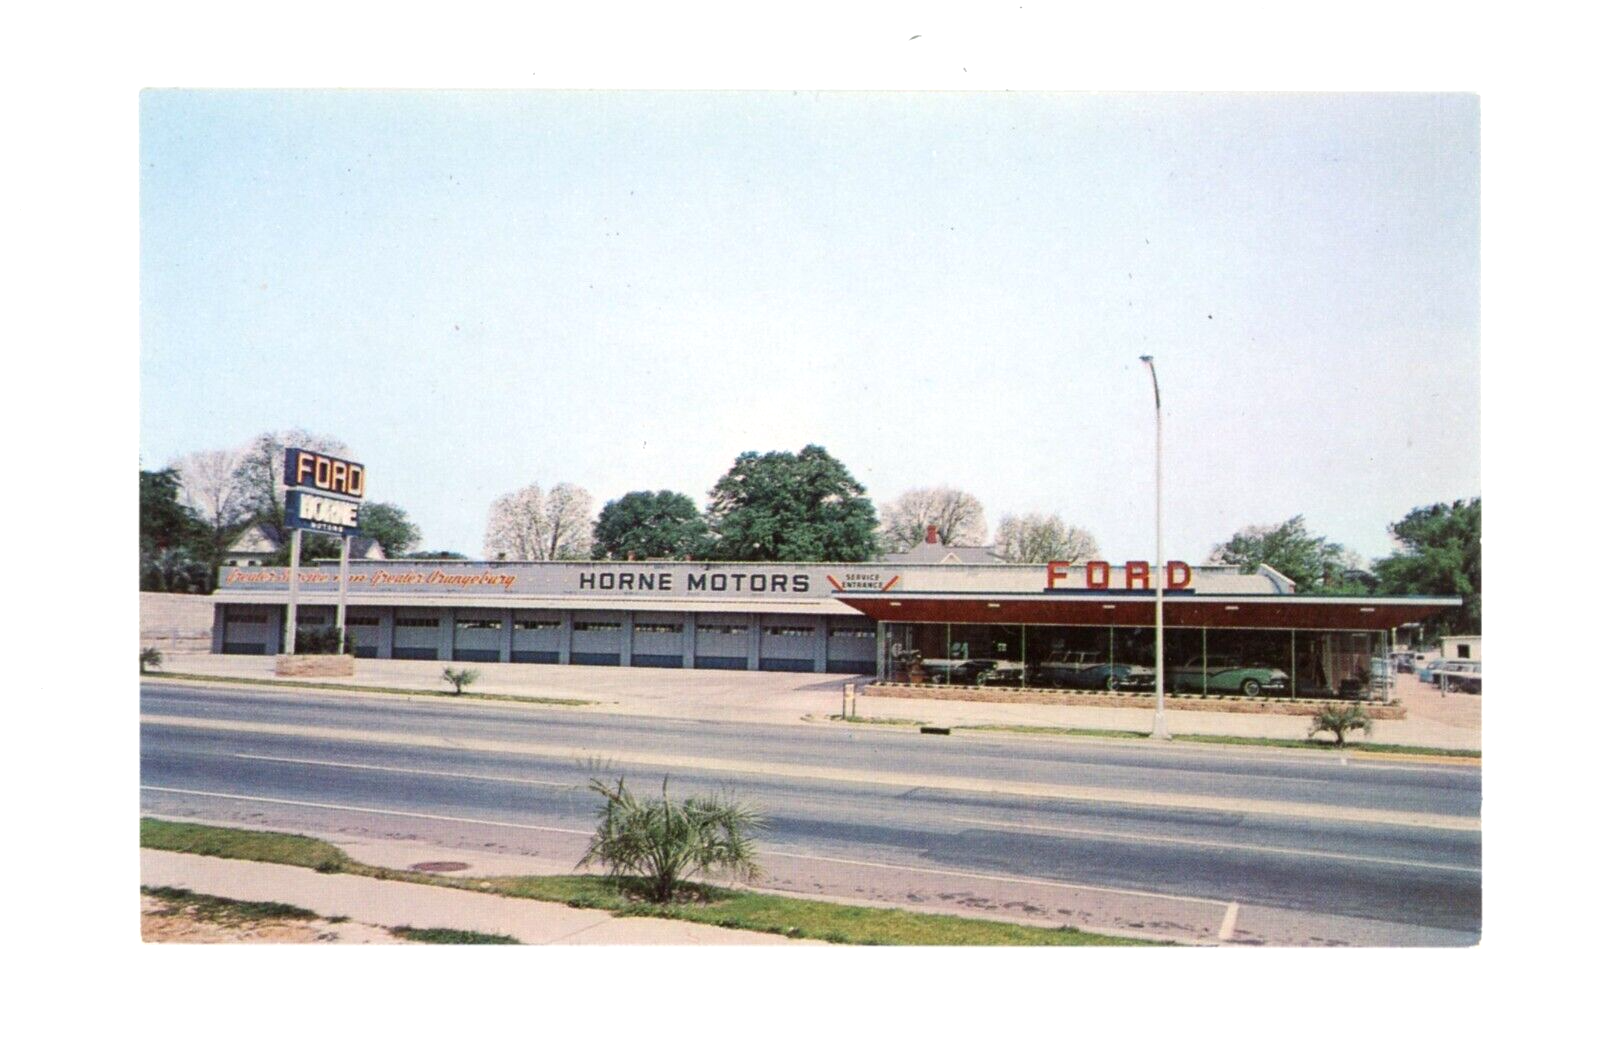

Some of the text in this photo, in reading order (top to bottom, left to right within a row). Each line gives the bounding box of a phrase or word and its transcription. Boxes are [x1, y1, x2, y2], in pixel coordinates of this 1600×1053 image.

[297, 451, 366, 497] FORD
[300, 493, 358, 527] HORNE
[371, 568, 424, 588] Greater
[425, 567, 516, 589] Orangeburg
[580, 572, 810, 593] HORNE MOTORS
[841, 581, 883, 589] ENTRANCE
[845, 573, 880, 581] SERVICE
[1046, 560, 1191, 590] FORD
